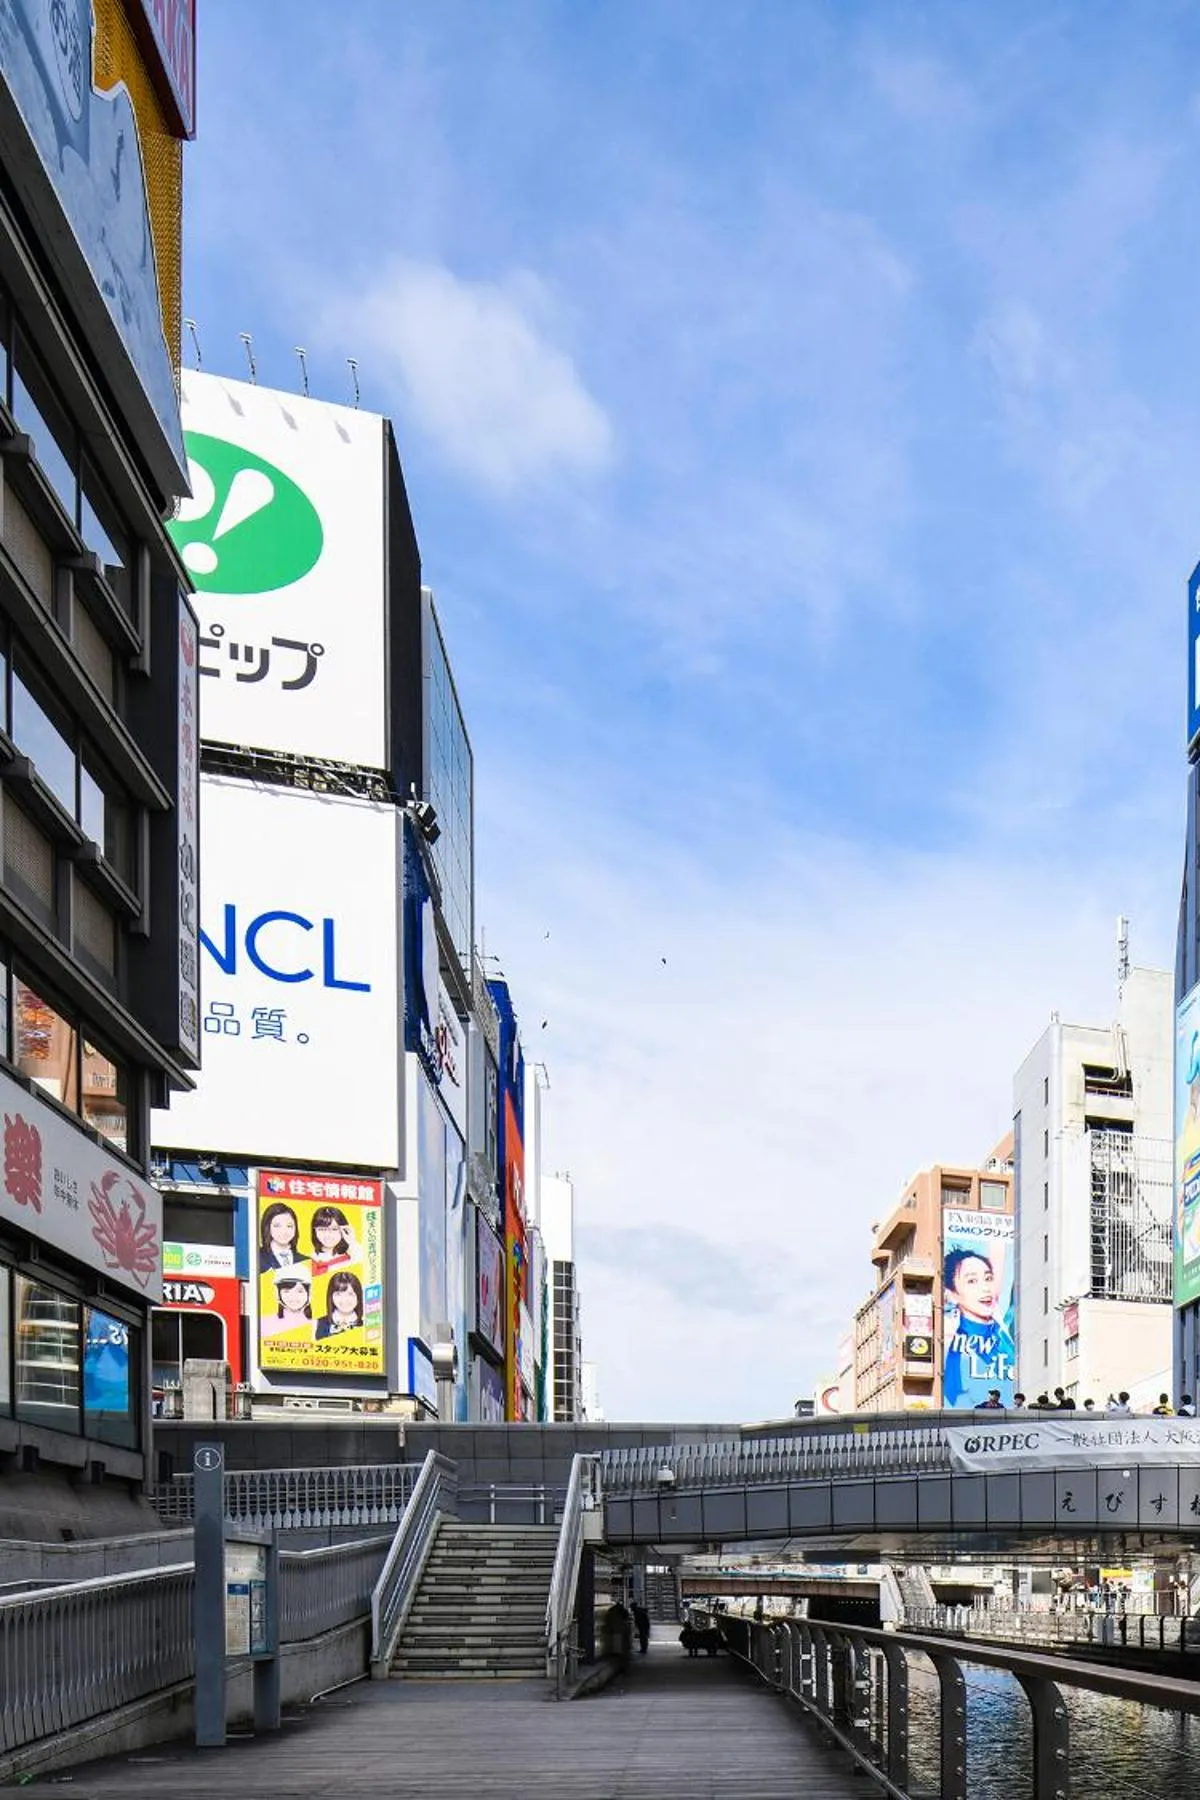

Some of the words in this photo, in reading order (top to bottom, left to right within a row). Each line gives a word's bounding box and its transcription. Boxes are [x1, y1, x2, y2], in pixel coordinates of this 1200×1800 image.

[200, 624, 325, 690] ピップ
[200, 904, 371, 992] NCL
[204, 1001, 309, 1044] 品質。
[288, 1178, 374, 1201] 住宅情報館
[315, 1344, 379, 1356] スタッフ大募集
[949, 1333, 996, 1355] new
[964, 1432, 1039, 1454] ORPEC
[1056, 1431, 1158, 1447] 一般社団法人
